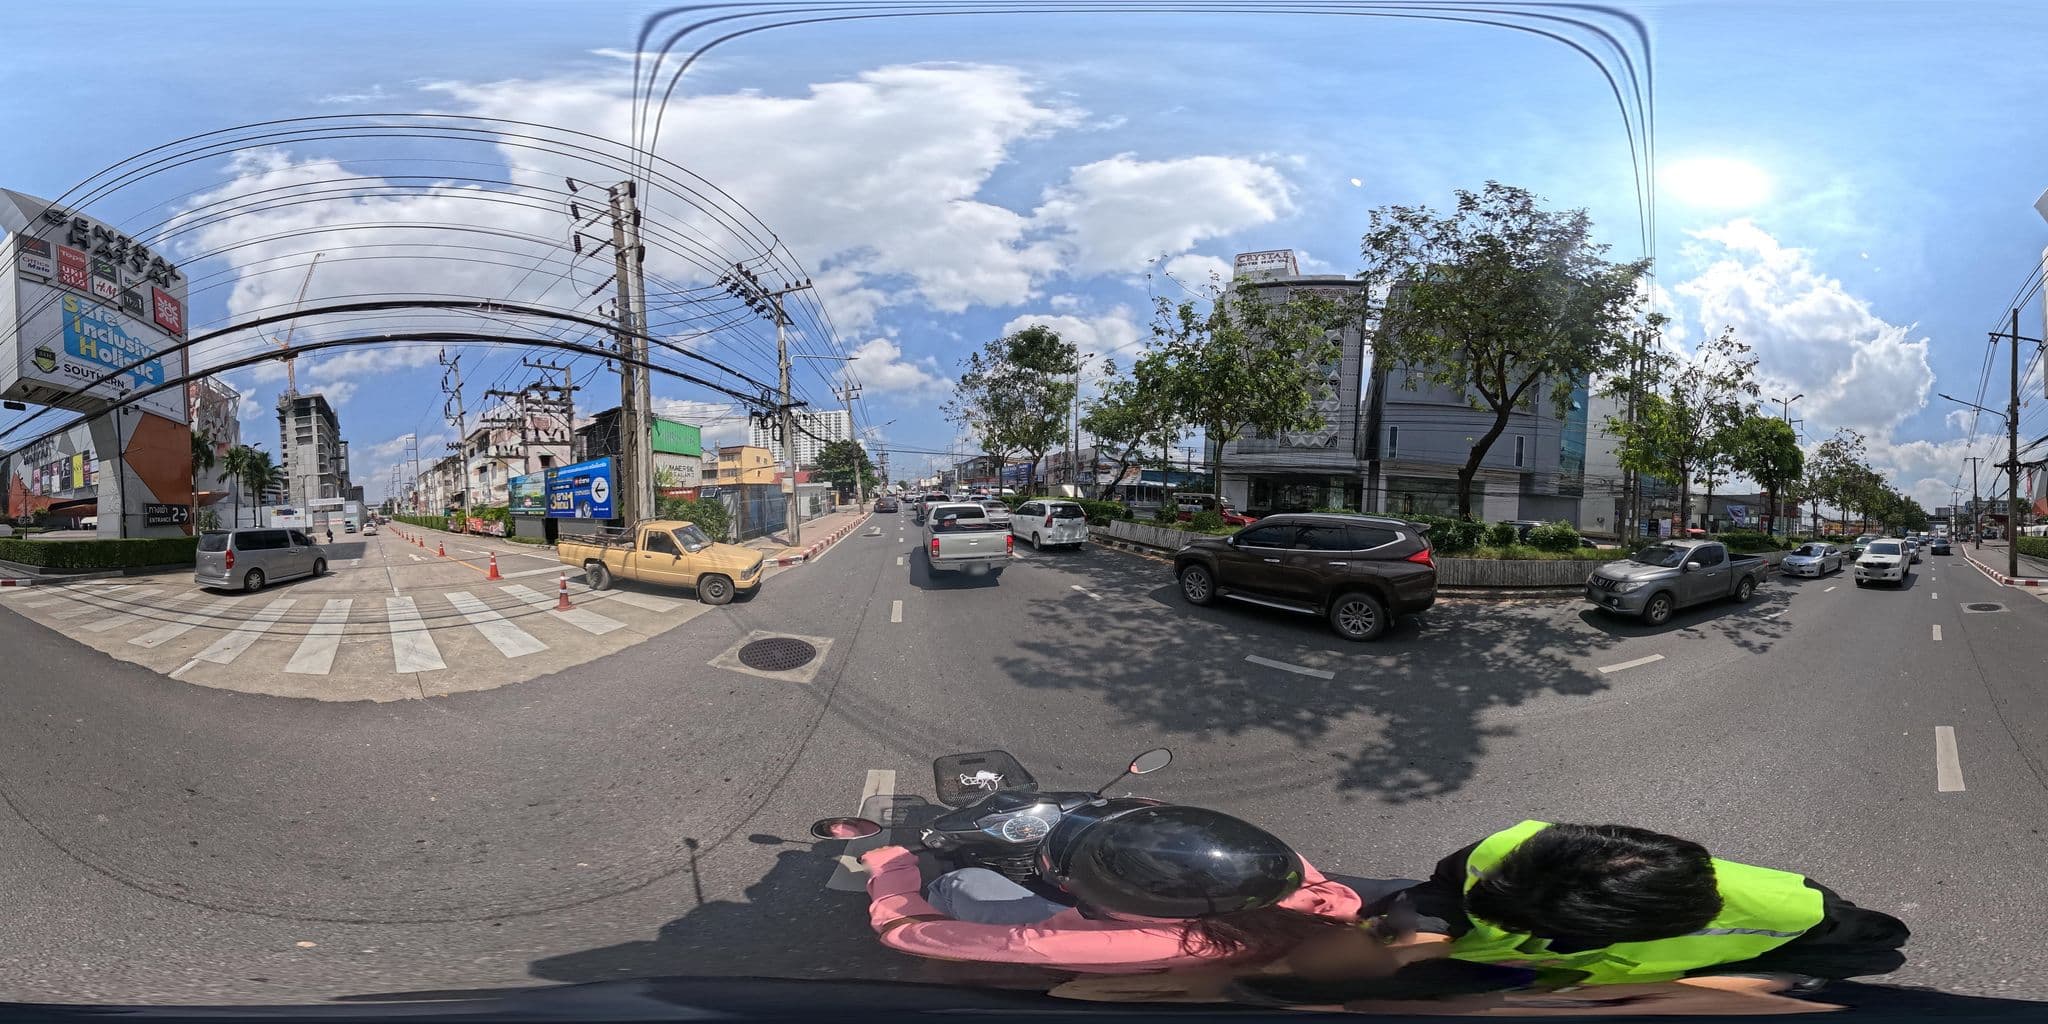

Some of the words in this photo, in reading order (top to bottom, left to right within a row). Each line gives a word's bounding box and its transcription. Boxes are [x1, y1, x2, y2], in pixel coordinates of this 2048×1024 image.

[45, 208, 181, 281] CENTRAL
[22, 256, 49, 268] Office
[1237, 252, 1289, 263] CRYSTAL
[27, 262, 50, 273] Mate
[62, 265, 83, 278] UNI
[63, 294, 118, 327] Safe
[74, 315, 160, 365] Inclusive
[64, 364, 124, 389] SOUTHERN
[172, 507, 179, 522] 2
